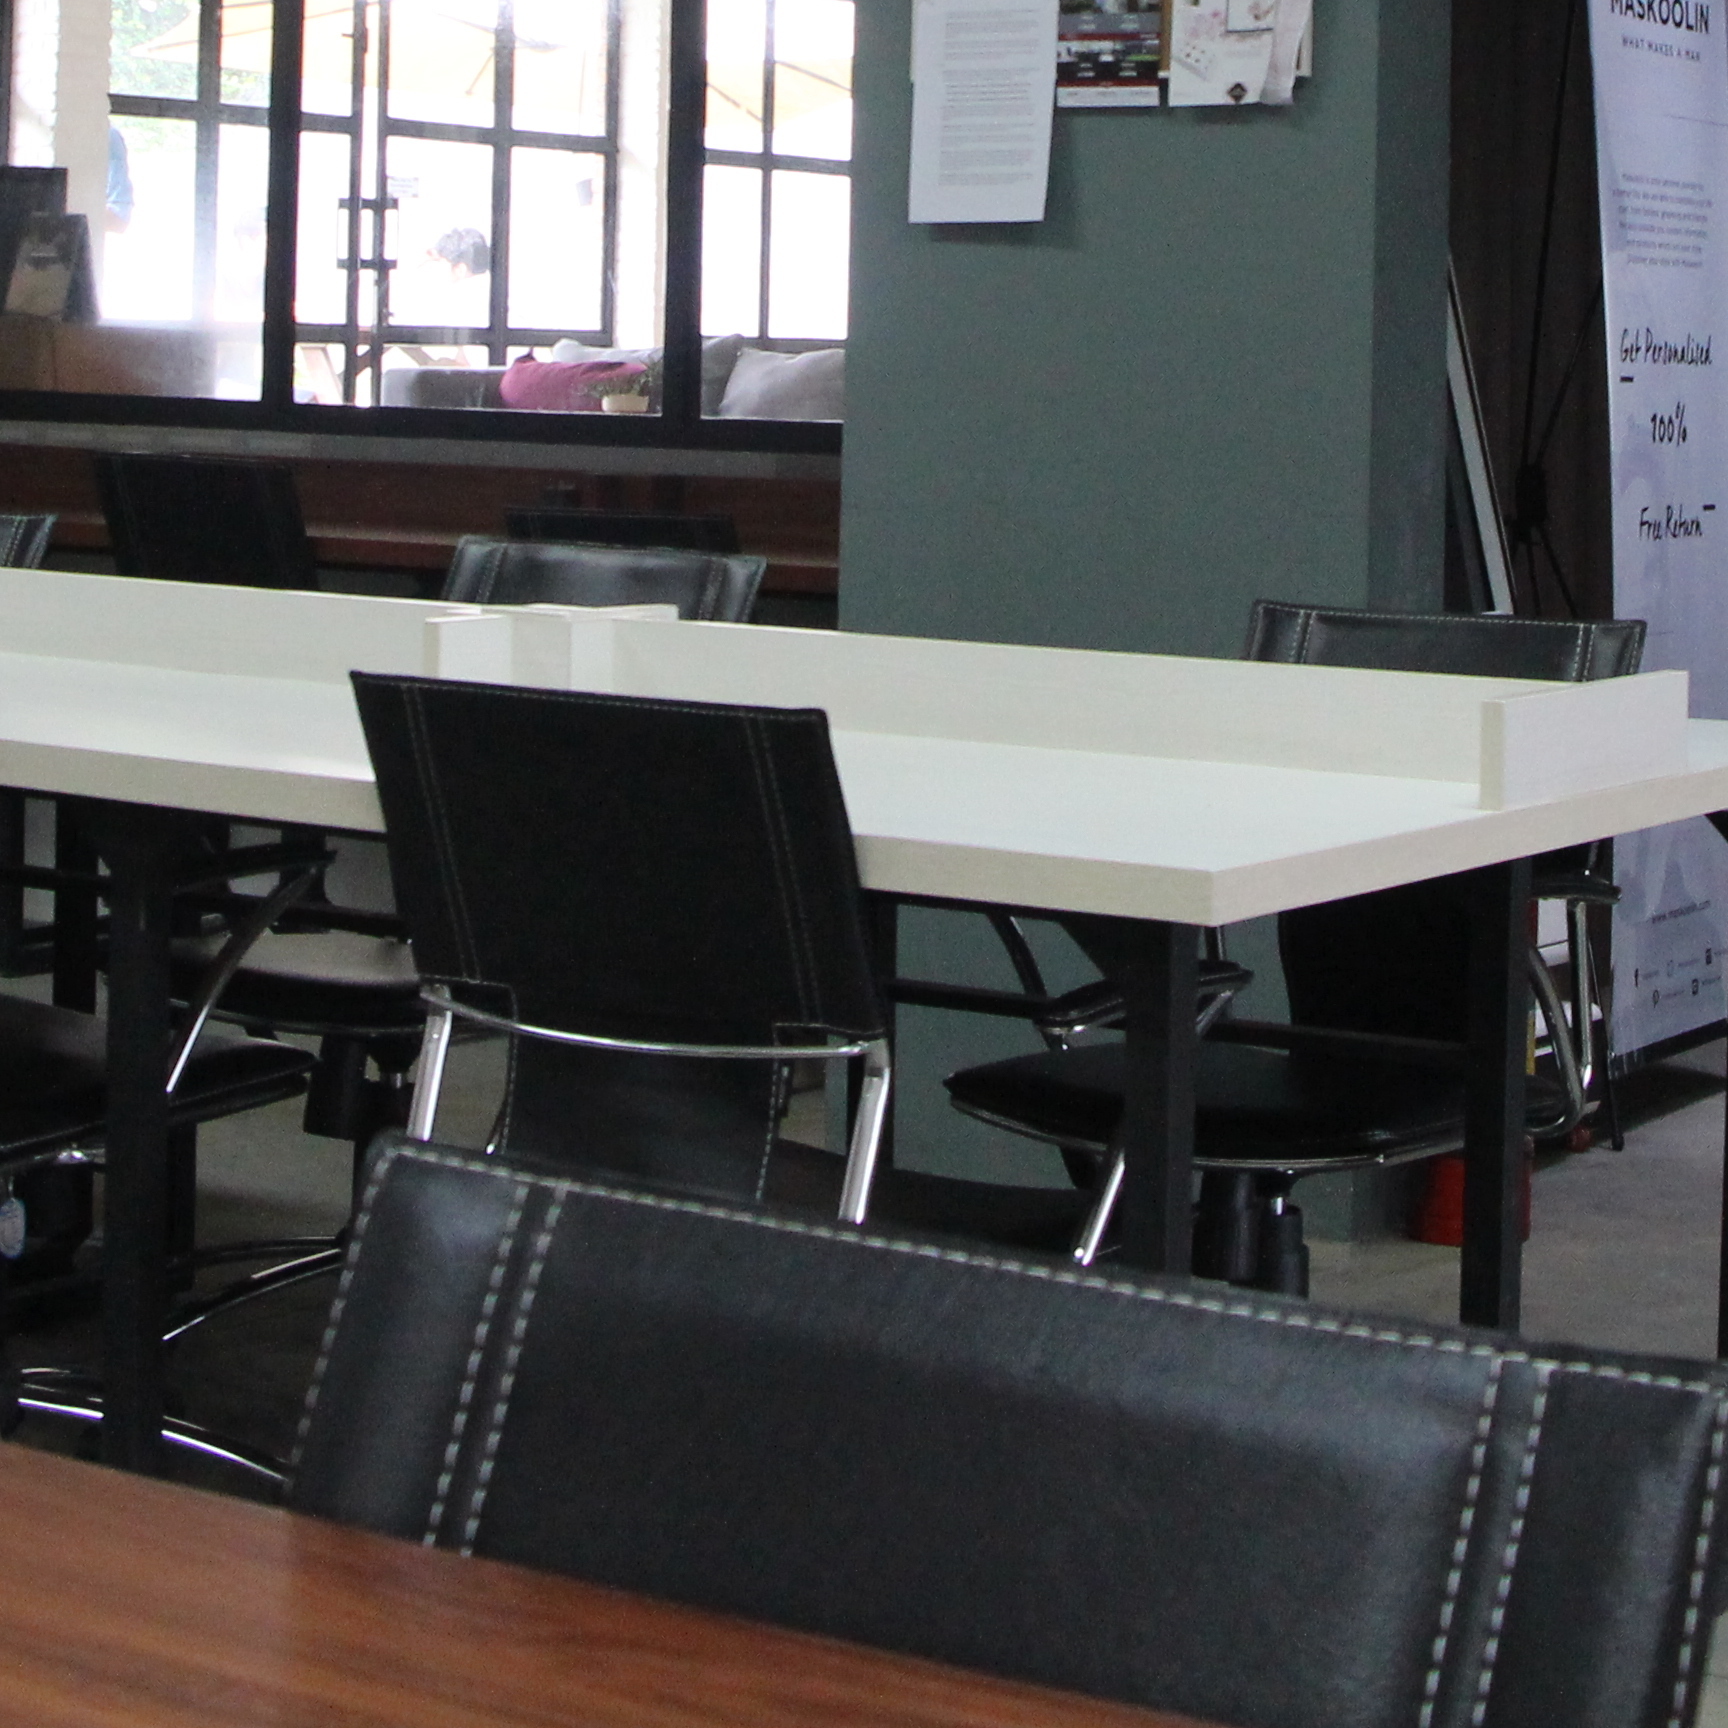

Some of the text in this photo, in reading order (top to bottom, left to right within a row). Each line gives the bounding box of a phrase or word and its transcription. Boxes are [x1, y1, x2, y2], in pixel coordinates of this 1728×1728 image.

[1620, 326, 1712, 366] Get Personalised
[1650, 401, 1687, 448] 100%
[1639, 504, 1702, 542] Free Return
